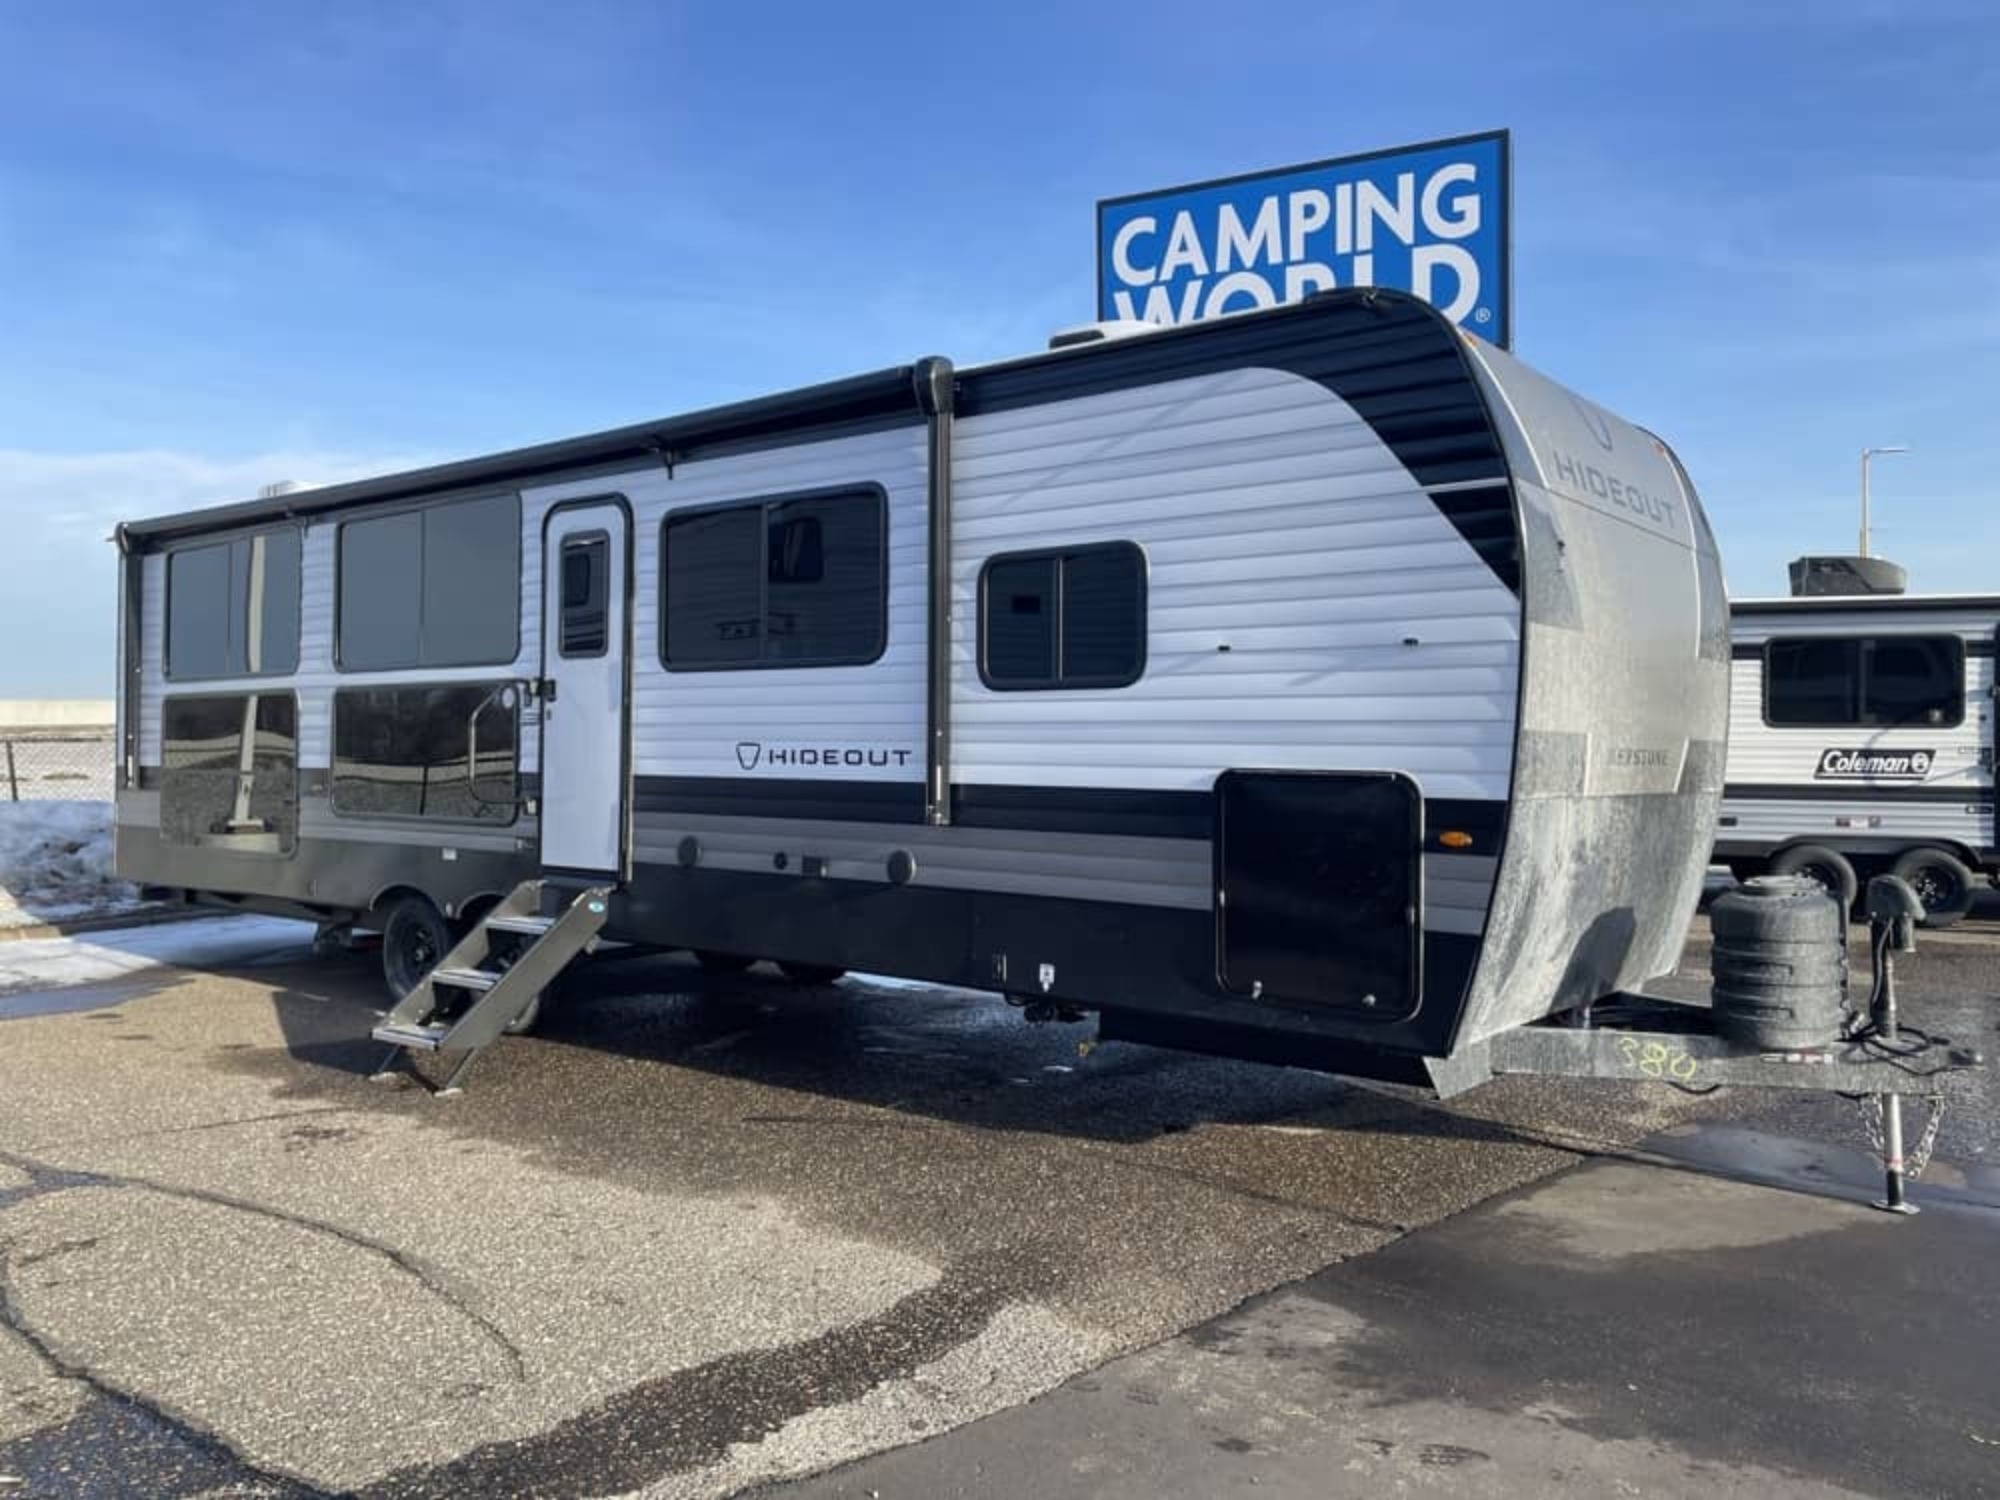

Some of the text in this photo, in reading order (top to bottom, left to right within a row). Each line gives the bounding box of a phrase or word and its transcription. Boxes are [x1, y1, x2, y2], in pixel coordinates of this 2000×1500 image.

[1111, 163, 1481, 287] CAMPING
[1553, 450, 1675, 528] HIDEOUT
[769, 748, 913, 767] HIDEOUT
[1608, 747, 1670, 768] EYSTONE
[1823, 751, 1909, 772] Coleman
